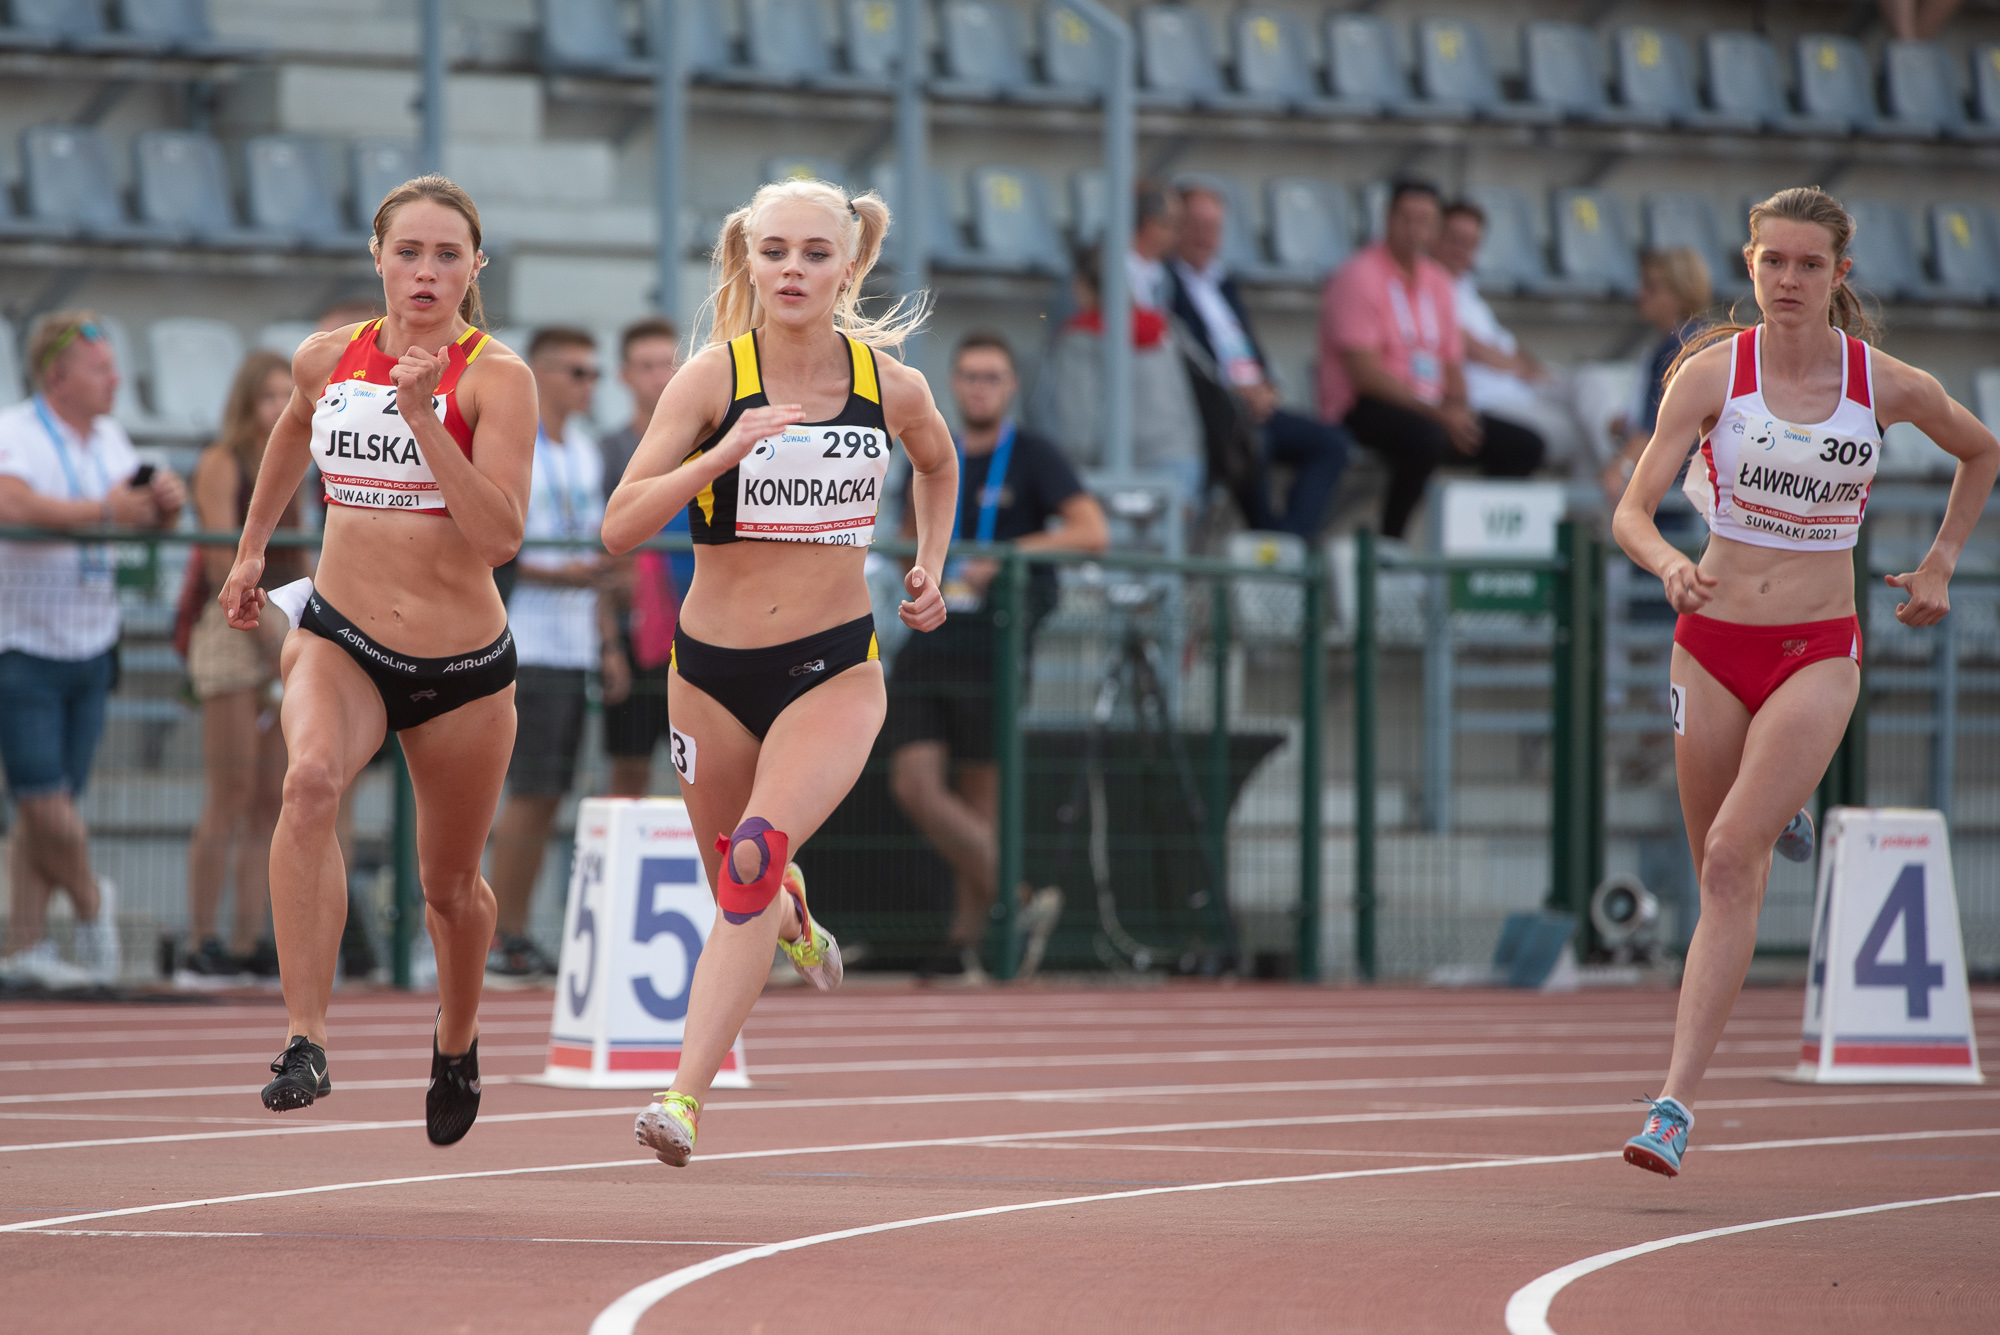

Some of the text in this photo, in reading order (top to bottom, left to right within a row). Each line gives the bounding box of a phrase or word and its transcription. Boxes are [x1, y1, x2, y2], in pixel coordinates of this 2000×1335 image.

[325, 430, 422, 466] JELSKA
[822, 431, 881, 458] 298
[1819, 437, 1873, 467] 309
[744, 476, 876, 507] KONDRACKA
[1739, 462, 1864, 504] ŁAWRUKAJTIS
[388, 494, 420, 507] 2021
[756, 523, 778, 532] PZLA
[779, 521, 833, 532] MISTRZOSTWA
[833, 518, 858, 529] POLSKI
[858, 517, 872, 525] U23
[1745, 514, 1838, 540] SUWAŁKI 2021
[1671, 687, 1680, 731] 2
[672, 731, 688, 774] 3
[631, 856, 703, 1022] 5
[1854, 862, 1945, 1022] 4
